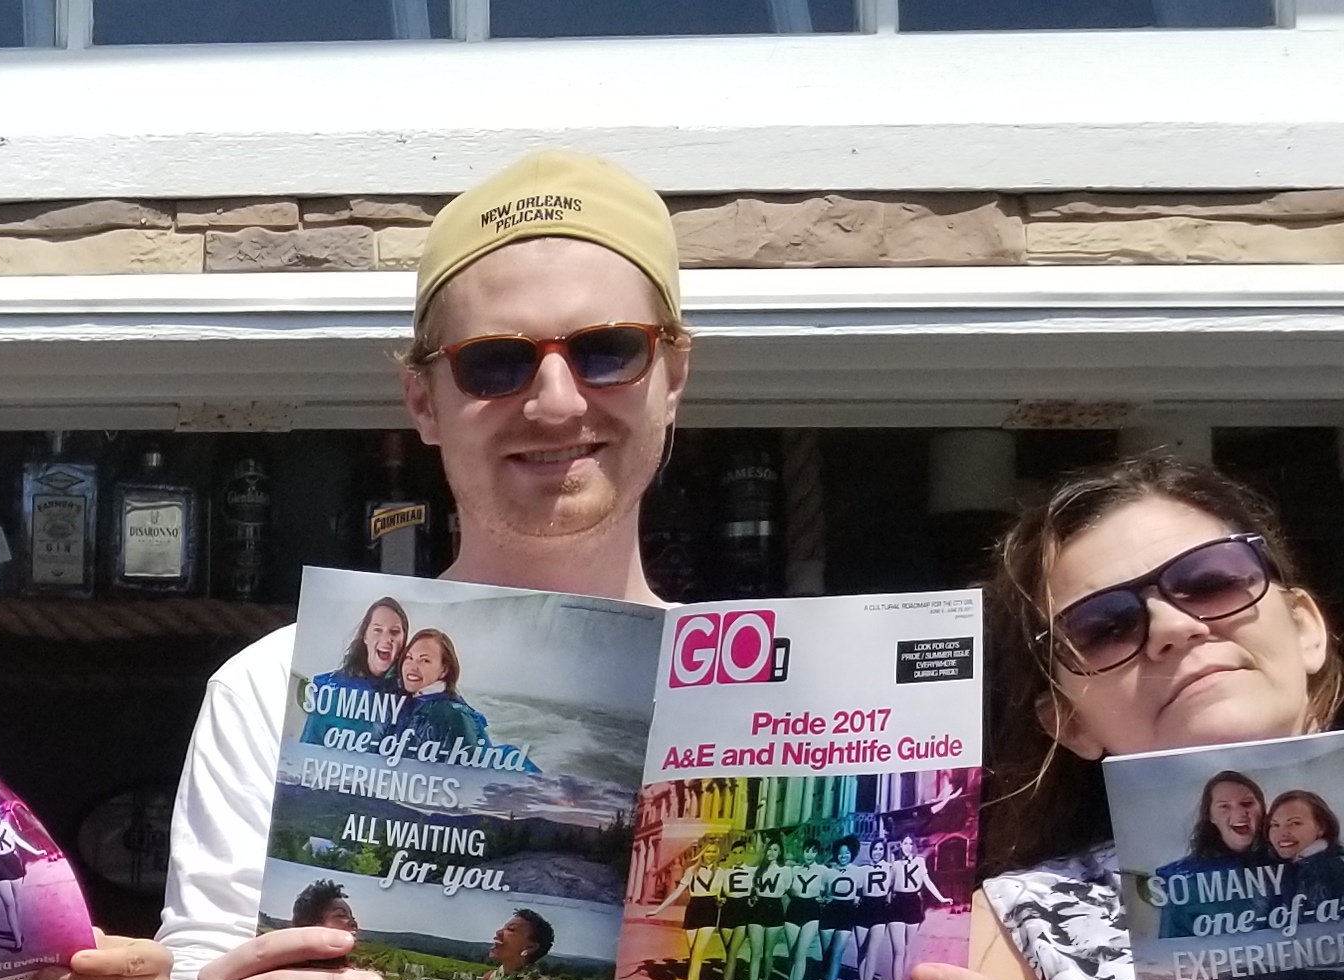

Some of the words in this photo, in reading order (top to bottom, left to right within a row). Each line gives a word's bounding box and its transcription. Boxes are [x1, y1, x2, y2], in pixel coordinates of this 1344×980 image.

[481, 202, 512, 228] NEW
[516, 194, 582, 212] ORLEANS
[495, 209, 564, 234] PELICANS
[130, 527, 178, 538] DISARONNO
[374, 508, 422, 534] COINTREAU
[46, 543, 71, 553] GIN
[303, 681, 333, 716] SO
[335, 686, 407, 725] MANY
[751, 711, 827, 737] Pride
[832, 708, 893, 734] 2017
[323, 725, 532, 772] one-of-a-kind
[661, 744, 716, 771] A&E
[721, 741, 774, 767] and
[781, 738, 892, 770] Nightlife
[897, 734, 963, 761] Guide
[341, 812, 380, 845] ALL
[385, 819, 486, 857] WAITING
[379, 850, 438, 889] for
[443, 863, 511, 897] you.
[1148, 873, 1189, 907] SO
[1196, 863, 1285, 904] MANY
